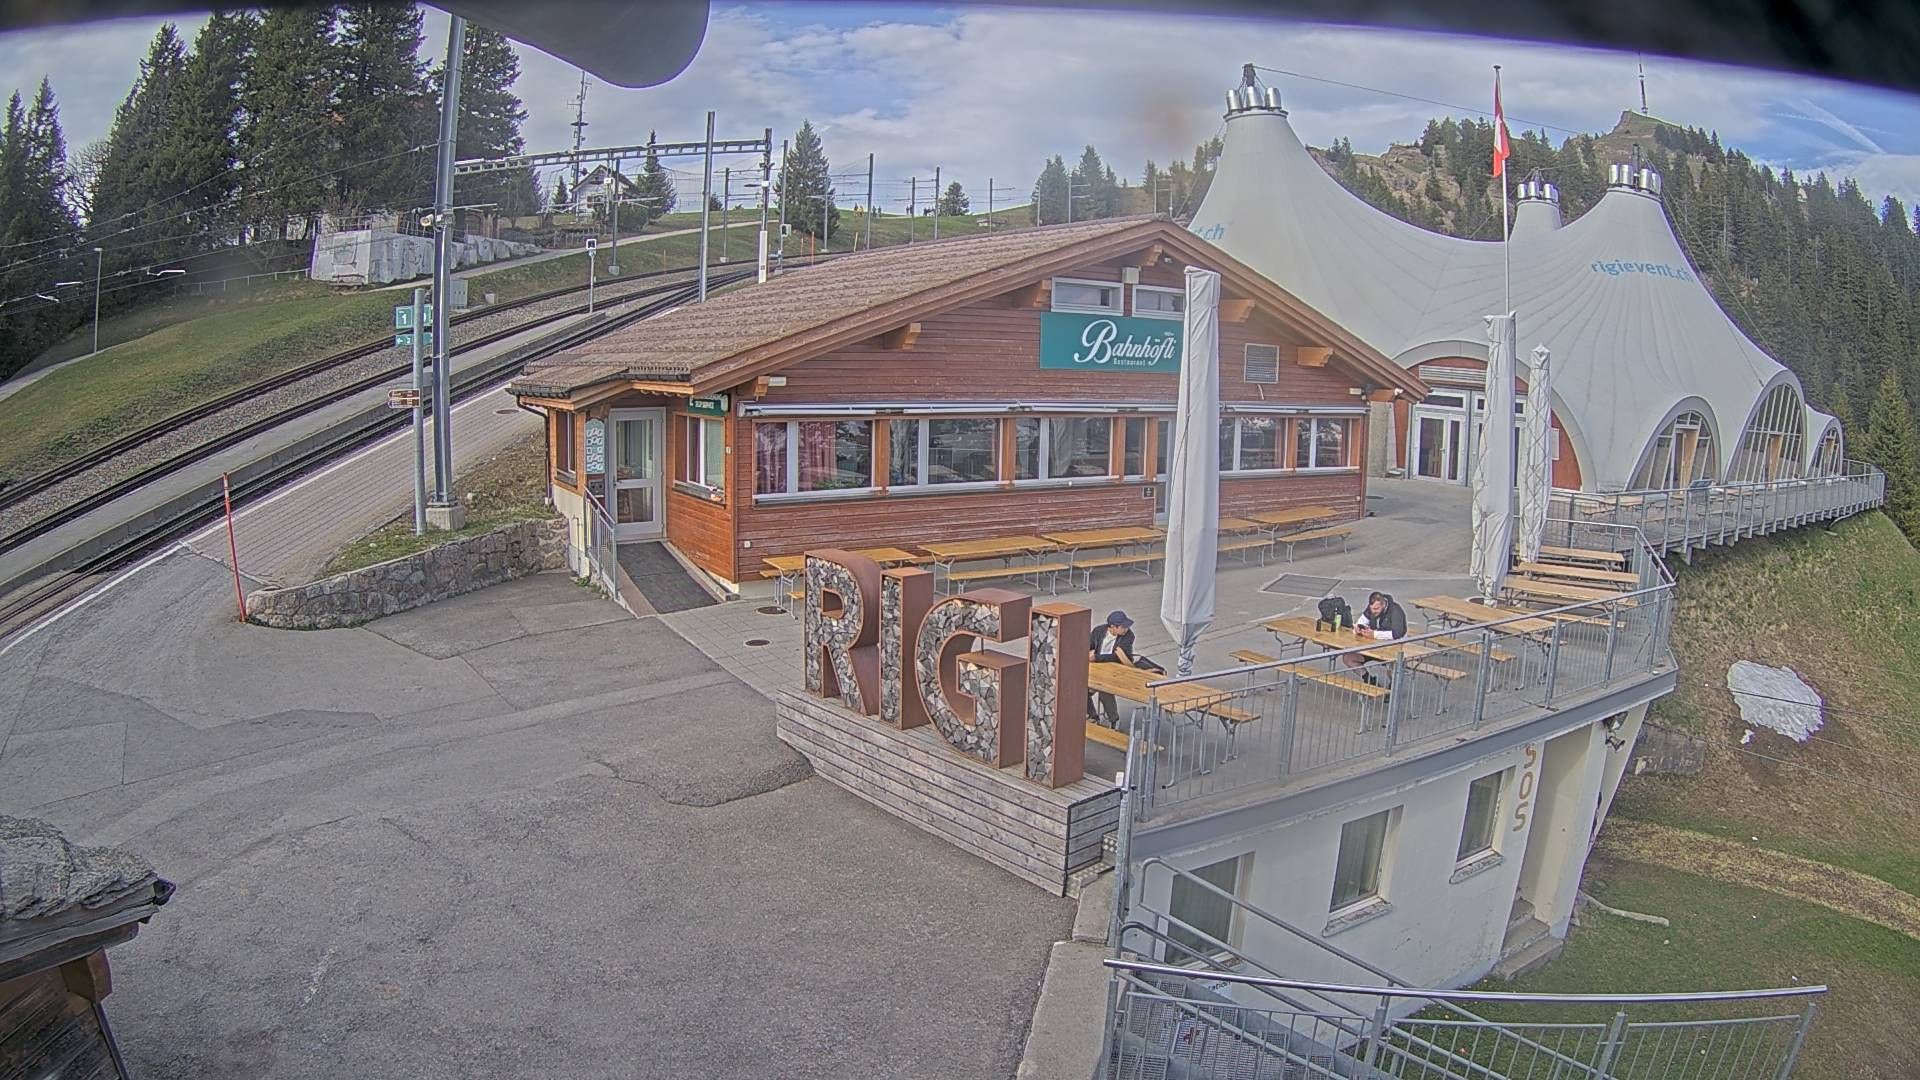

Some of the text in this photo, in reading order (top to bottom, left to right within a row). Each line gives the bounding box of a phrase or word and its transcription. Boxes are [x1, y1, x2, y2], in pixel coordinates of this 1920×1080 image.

[1591, 260, 1694, 282] rigievent.ch
[402, 313, 407, 325] 1
[1074, 319, 1176, 366] Bahnhöfli
[1114, 358, 1146, 367] Restaurant
[804, 549, 1091, 789] RIGI
[1513, 745, 1537, 832] SOS
